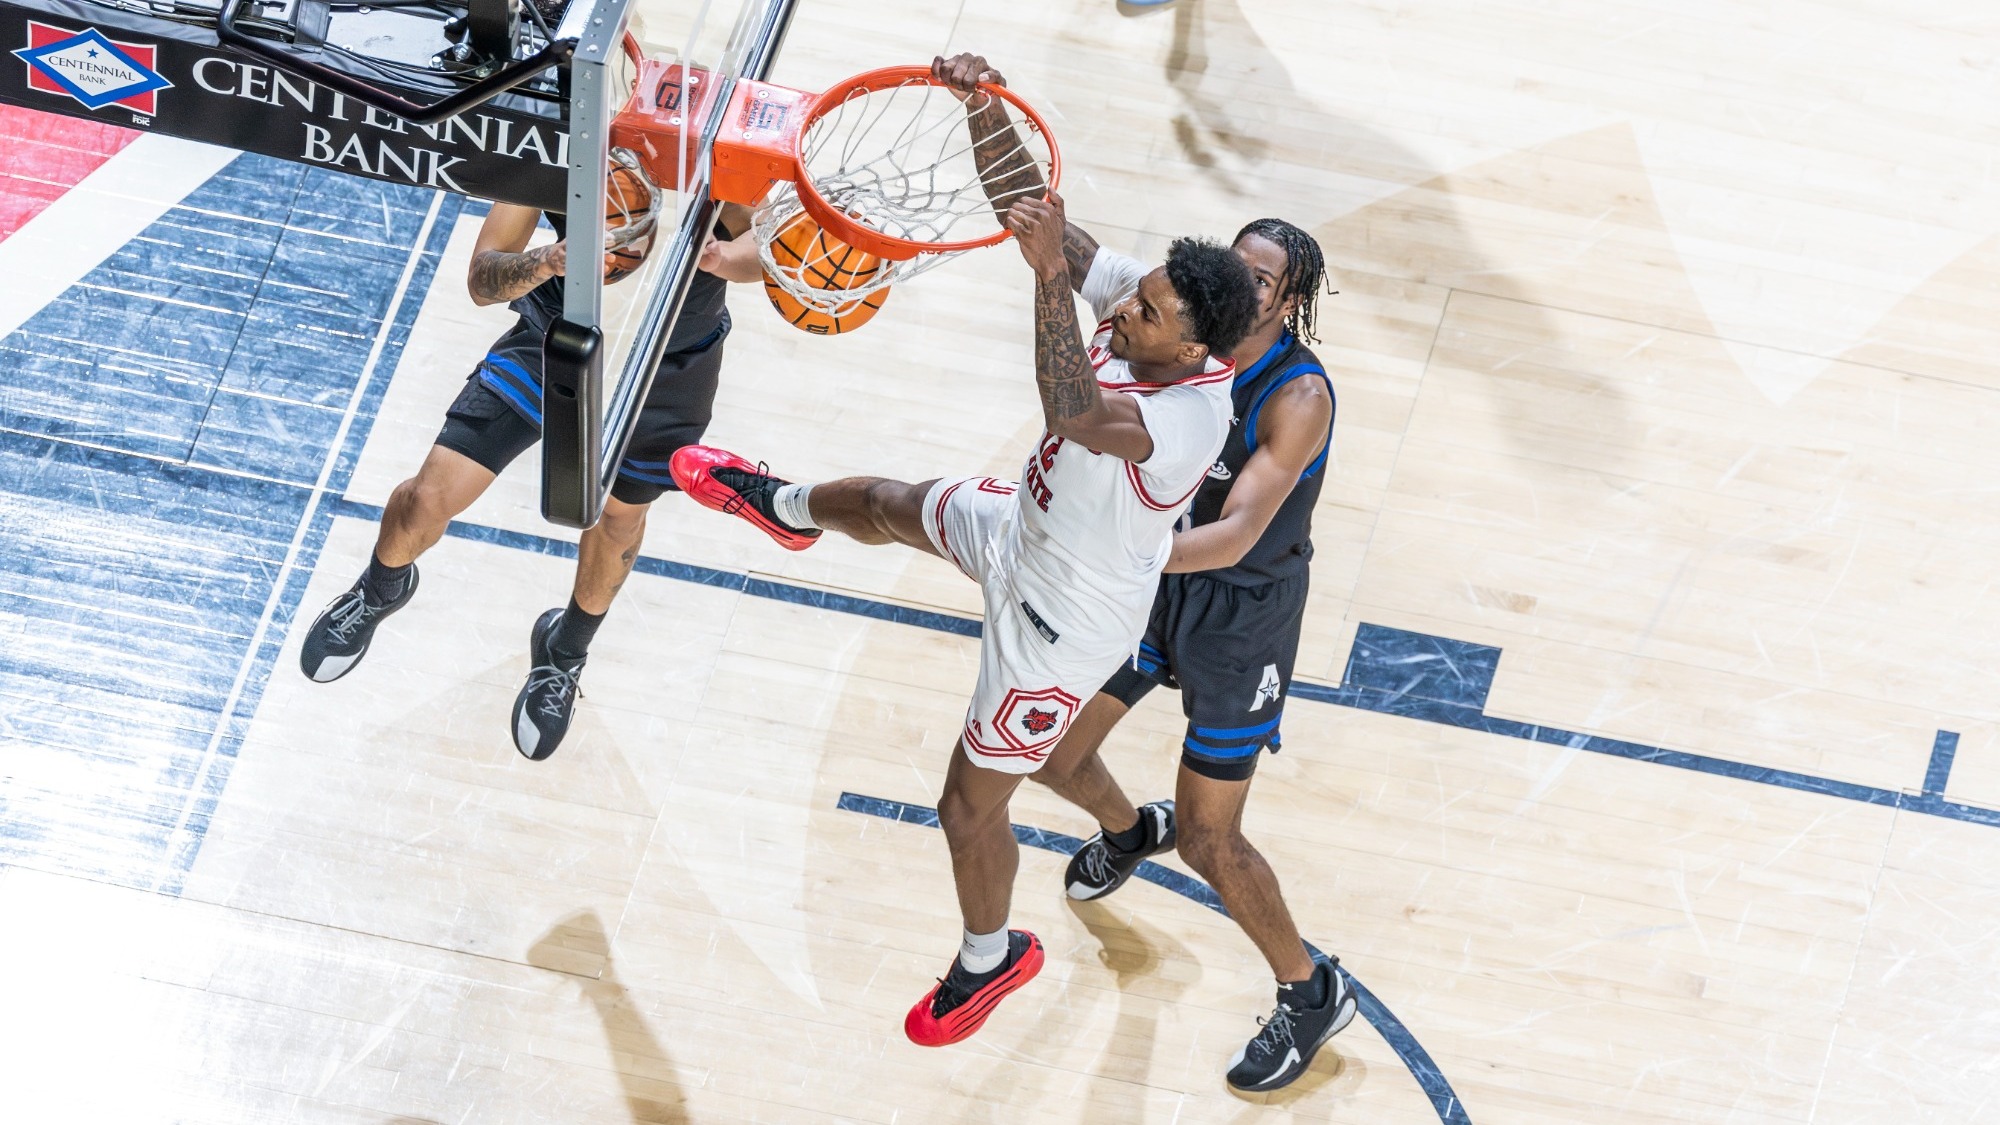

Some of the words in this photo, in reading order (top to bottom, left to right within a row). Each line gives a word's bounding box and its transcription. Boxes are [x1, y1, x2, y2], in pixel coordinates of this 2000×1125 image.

[48, 55, 136, 82] CENTENNIAL
[79, 73, 106, 86] BANK
[132, 117, 150, 127] FDIC
[301, 121, 471, 194] BANK
